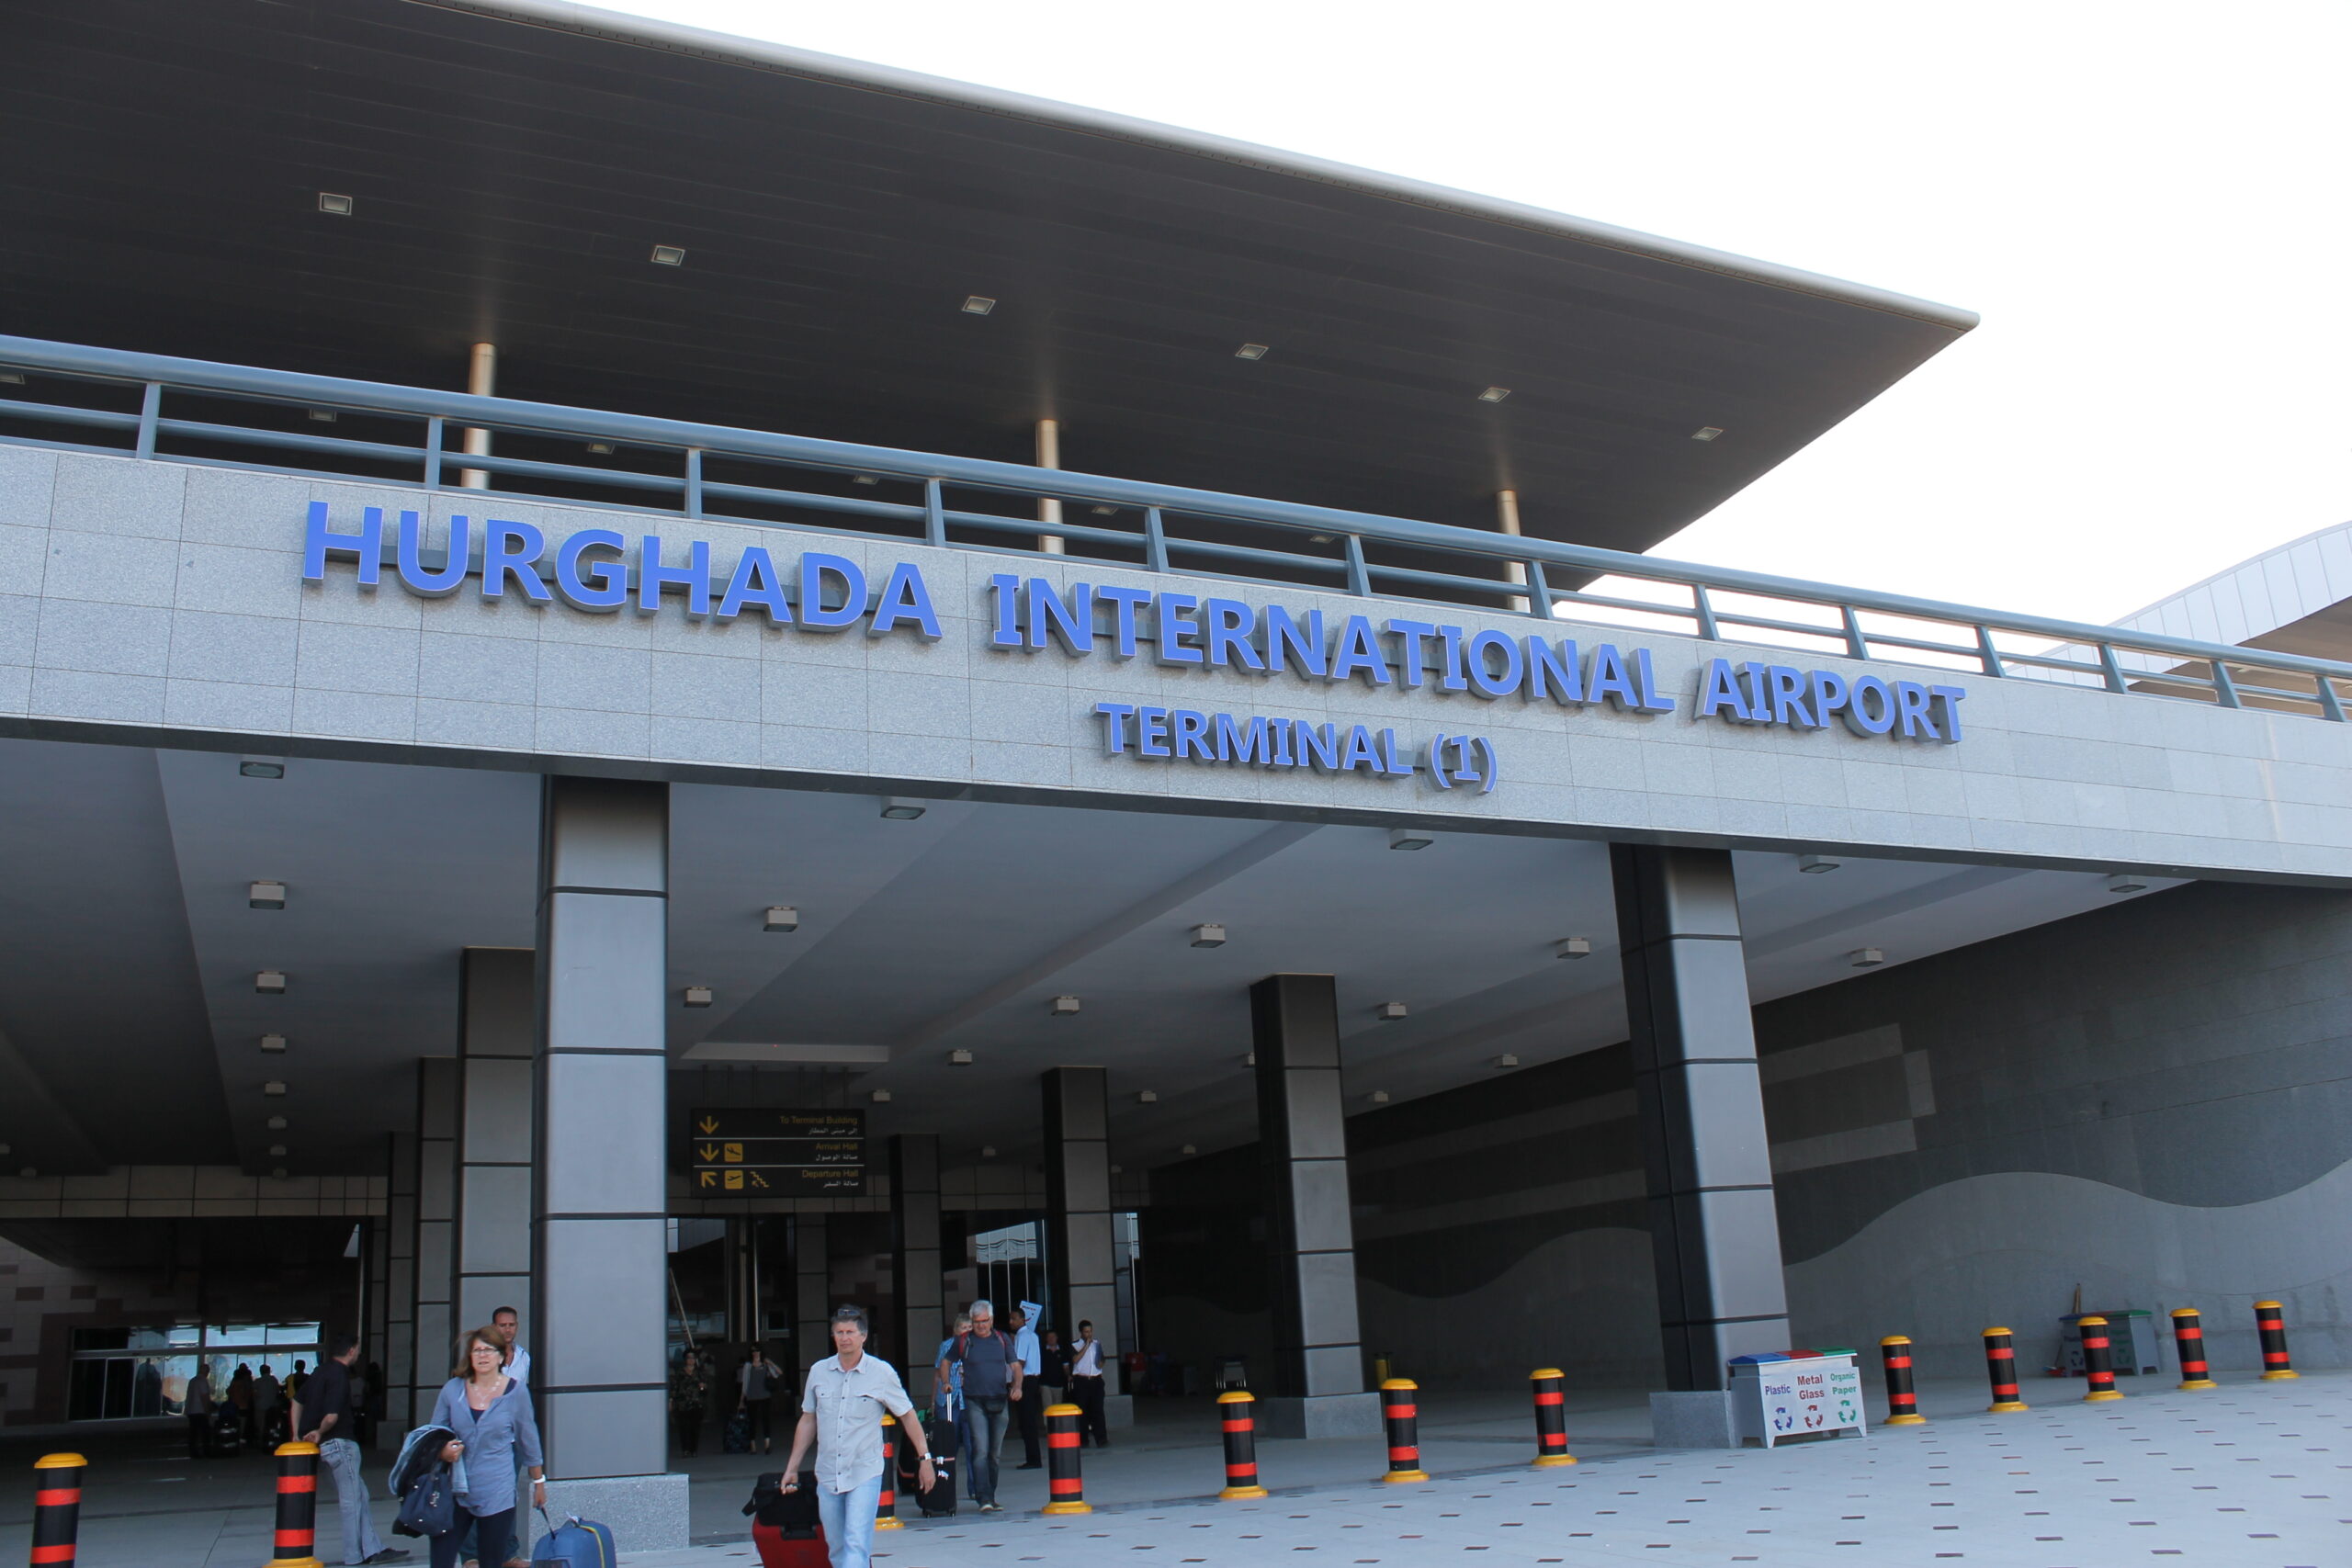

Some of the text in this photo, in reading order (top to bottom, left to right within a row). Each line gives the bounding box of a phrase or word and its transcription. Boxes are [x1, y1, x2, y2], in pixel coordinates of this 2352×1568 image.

[303, 501, 1967, 745] HURGHADA INTERNATIONAL AIRPORT
[1092, 701, 1498, 795] TERMINAL (1)
[780, 1116, 858, 1125] To Terminal Building
[816, 1143, 841, 1151] Arrival
[802, 1169, 859, 1179] Departure Hall
[1797, 1374, 1823, 1386] Metal
[1830, 1371, 1855, 1382] Organic
[1765, 1384, 1791, 1395] Plastic
[1799, 1389, 1825, 1400] Glass
[1832, 1385, 1857, 1395] Paper
